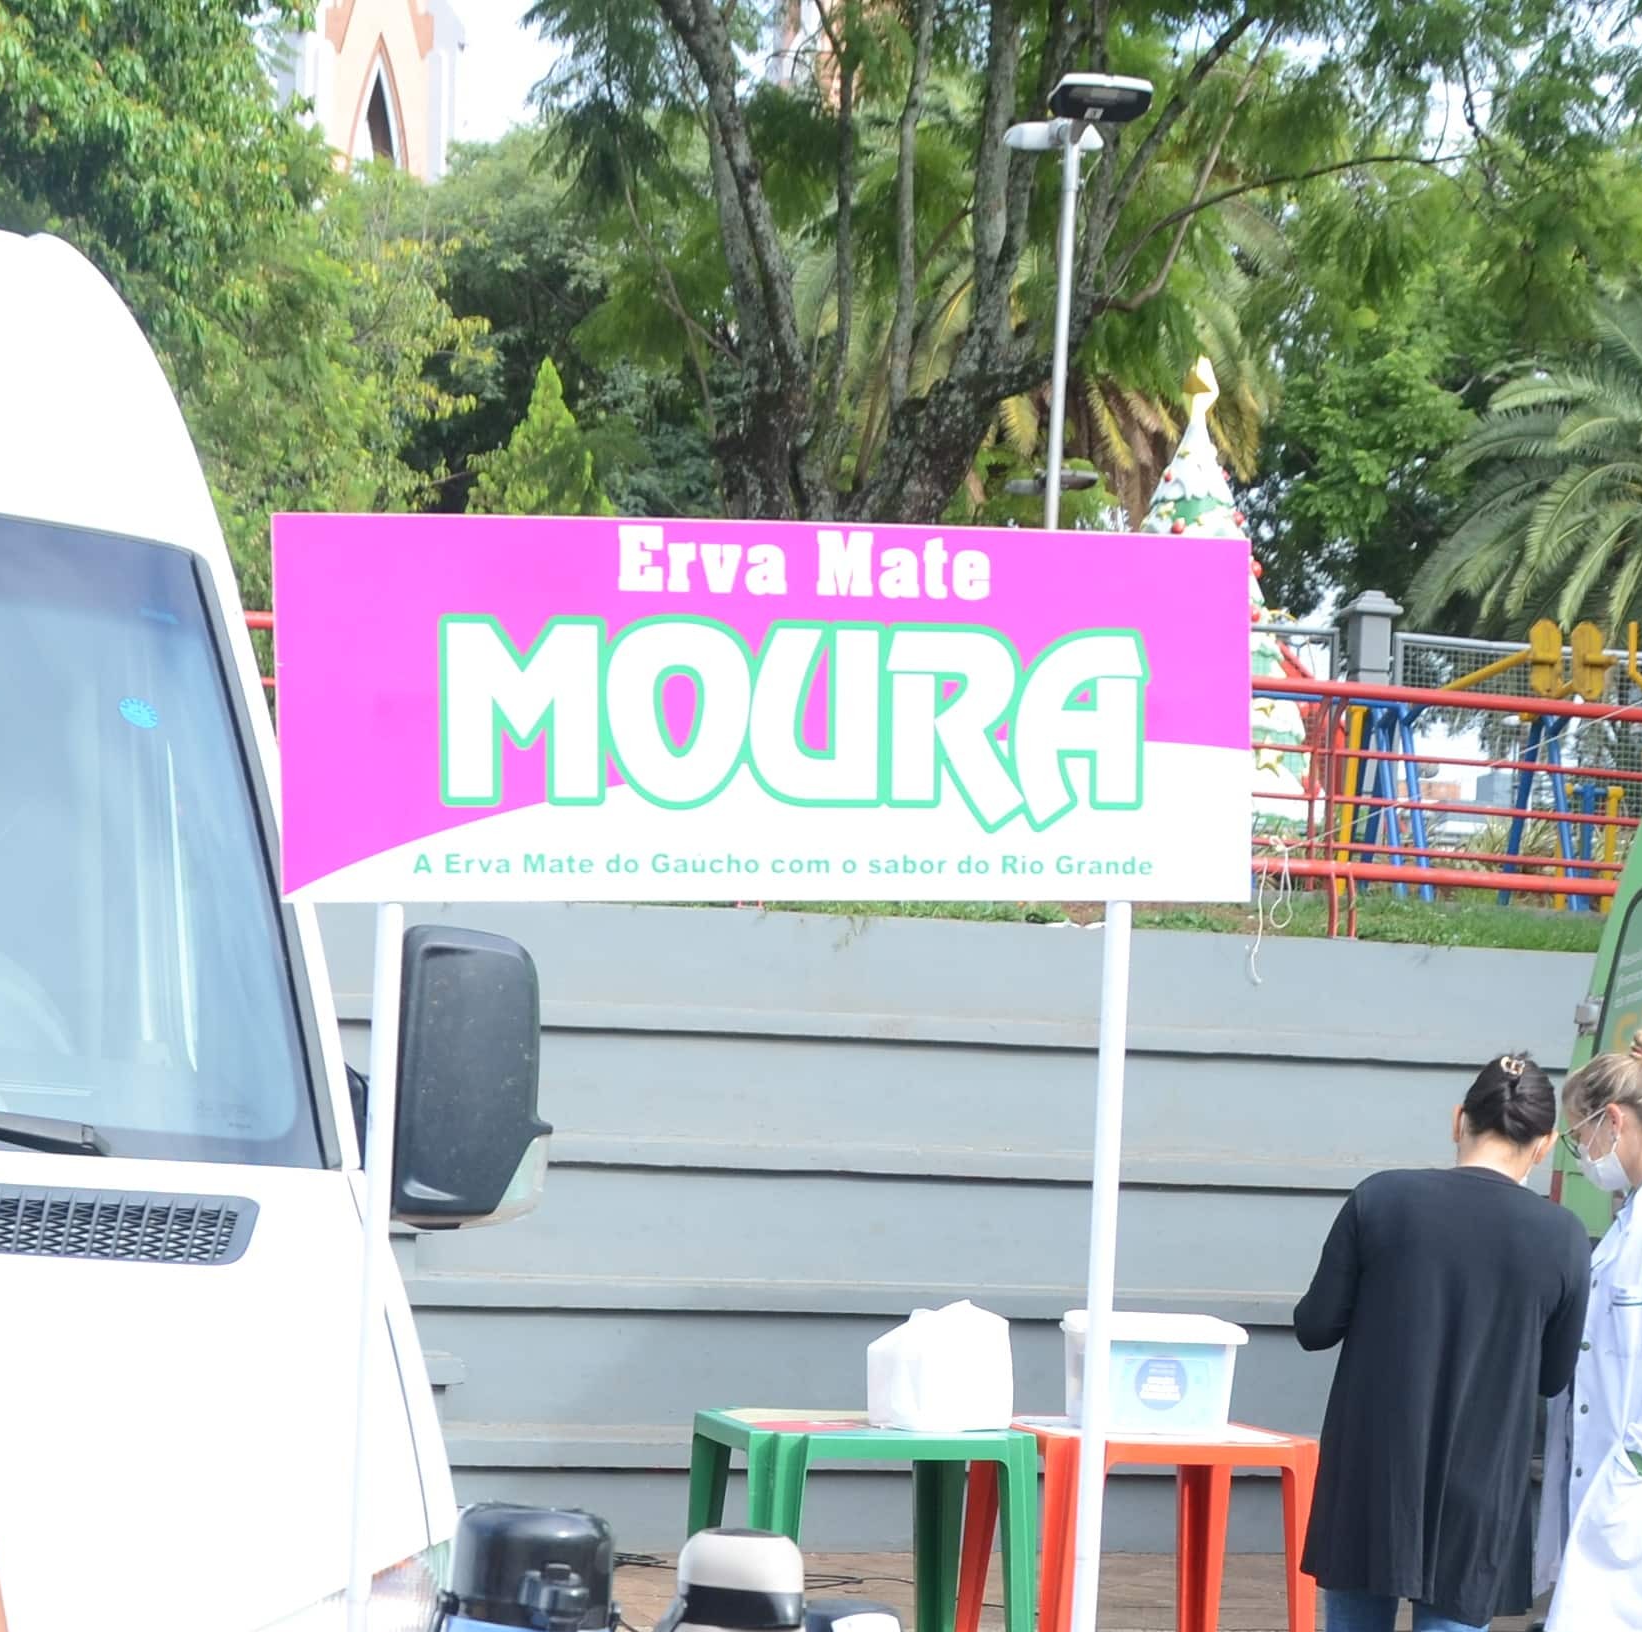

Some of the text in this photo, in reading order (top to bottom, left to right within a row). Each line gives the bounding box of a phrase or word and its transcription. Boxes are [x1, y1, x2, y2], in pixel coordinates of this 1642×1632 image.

[618, 525, 991, 602] Erva Mate
[438, 612, 1150, 834] MOURA
[413, 852, 1154, 876] A Erva Mate do Gaúcho com o sabor do Rio Grande
